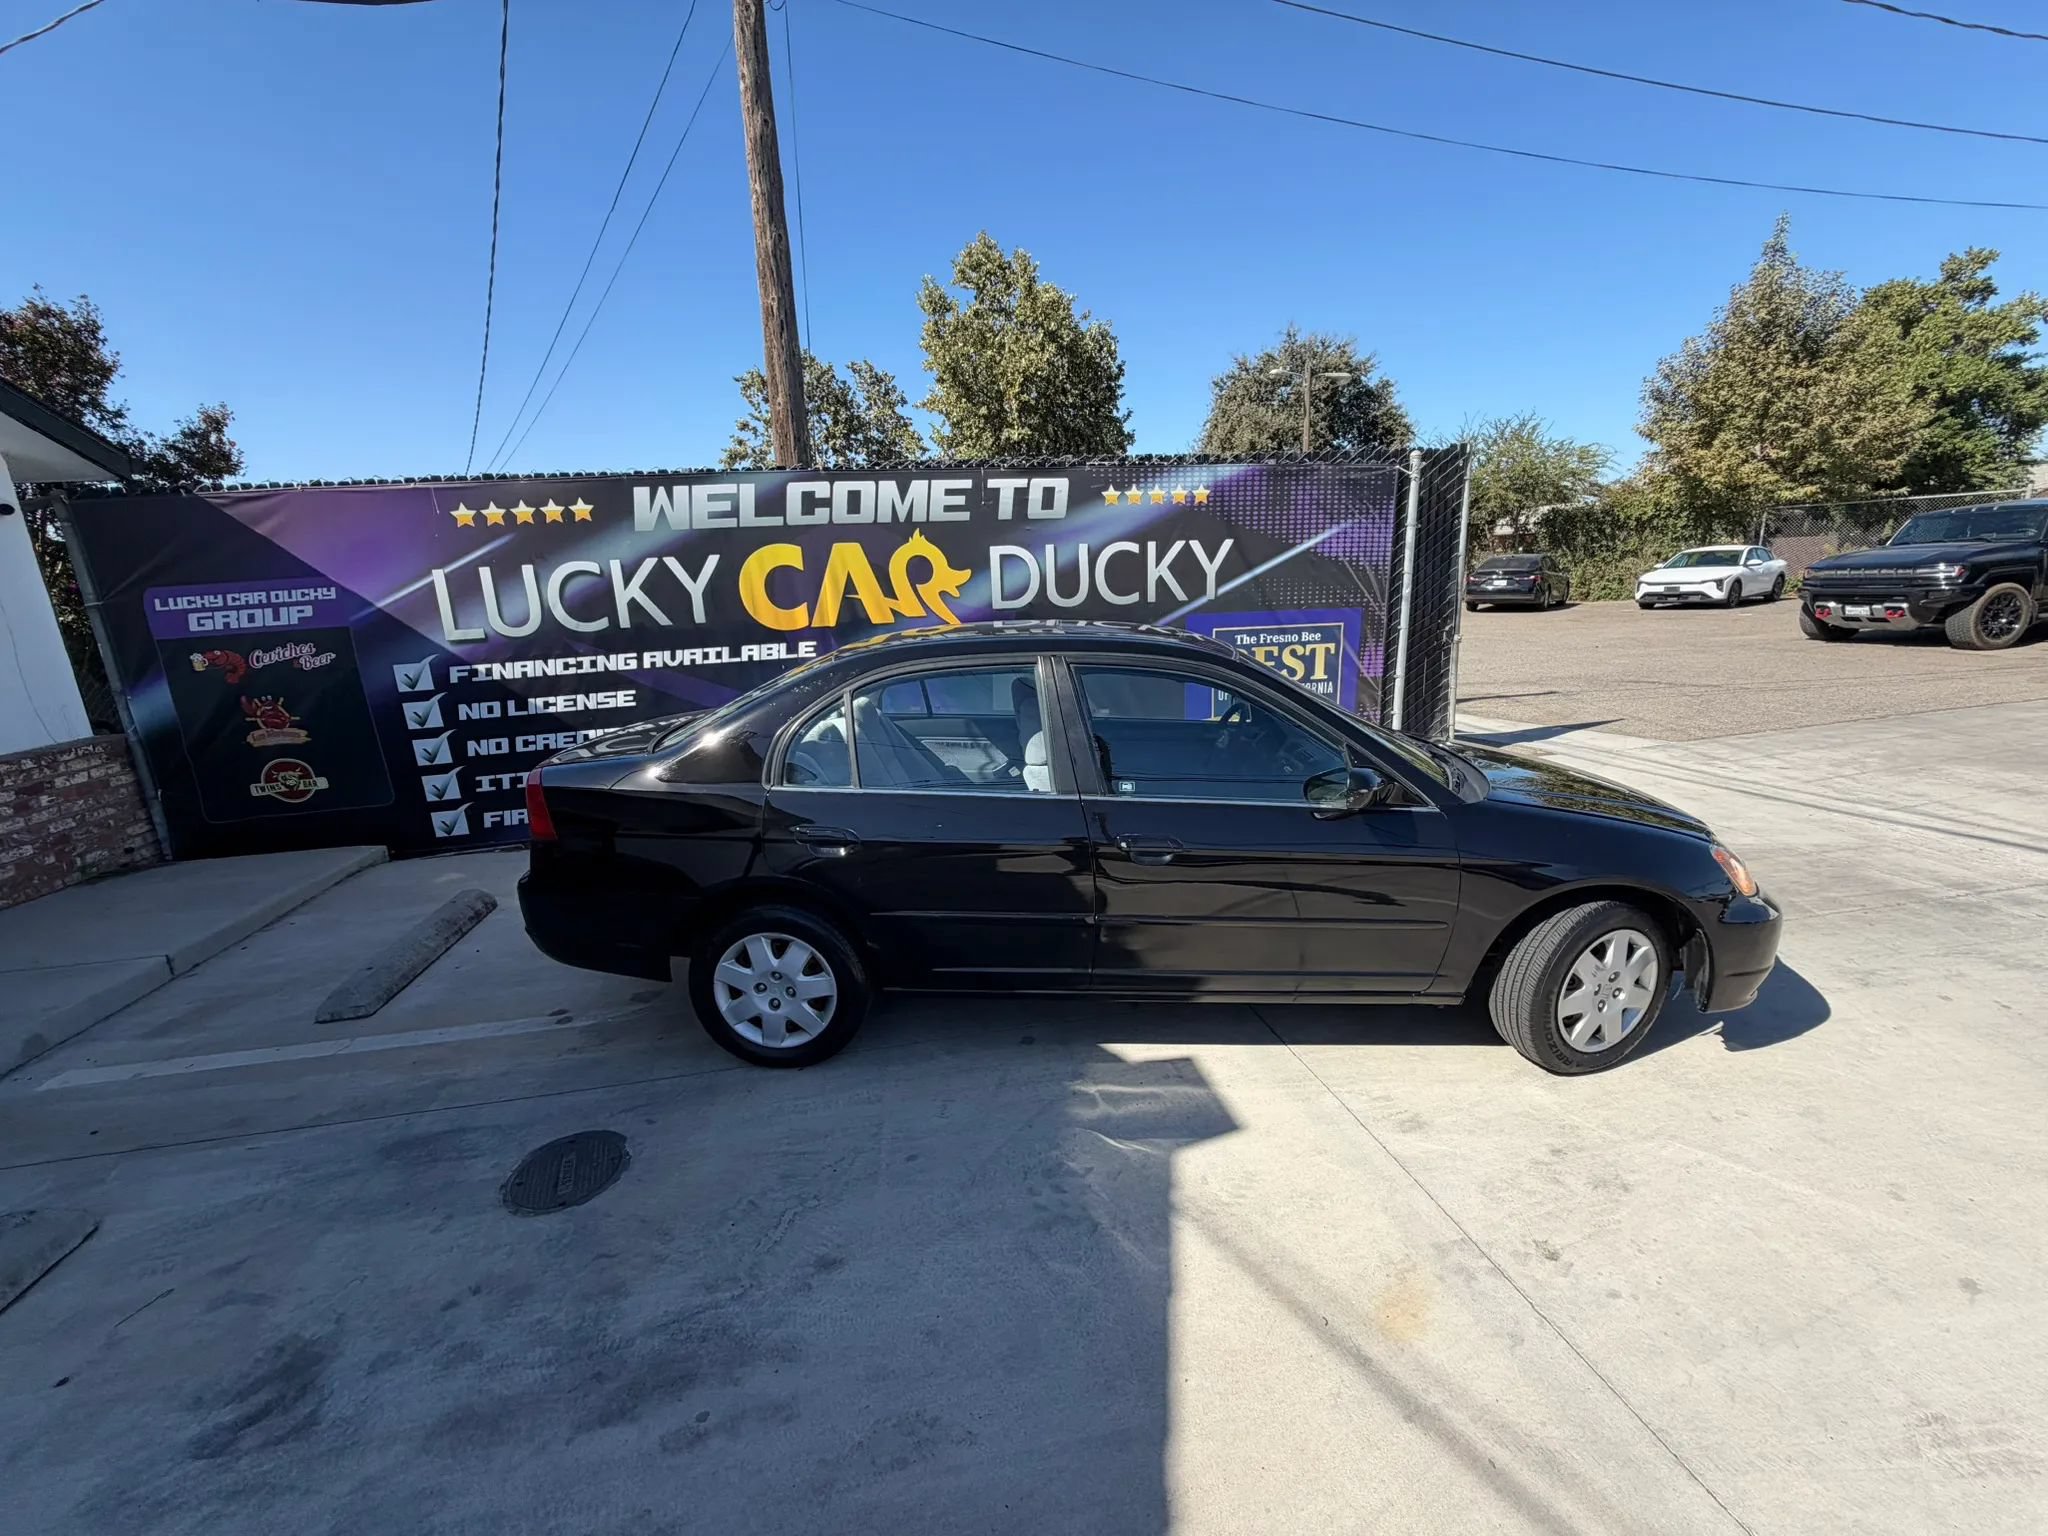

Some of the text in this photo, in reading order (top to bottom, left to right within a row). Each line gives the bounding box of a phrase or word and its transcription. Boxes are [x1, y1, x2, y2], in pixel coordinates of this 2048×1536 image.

[632, 477, 1070, 532] WELCOME TO
[431, 528, 1236, 642] LUCKY CAR DUCKY
[154, 587, 337, 611] LUCKY CAR DUCKY
[187, 605, 314, 632] GROUP
[1235, 631, 1322, 645] The Fresno Bee
[250, 643, 316, 669] Ceviches
[298, 651, 337, 671] Beer
[450, 641, 817, 684] FINANCING AVAILABLE
[1237, 643, 1336, 681] EST
[458, 690, 637, 721] NO LICENSE
[467, 737, 509, 757] NO
[254, 783, 282, 794] TWINS
